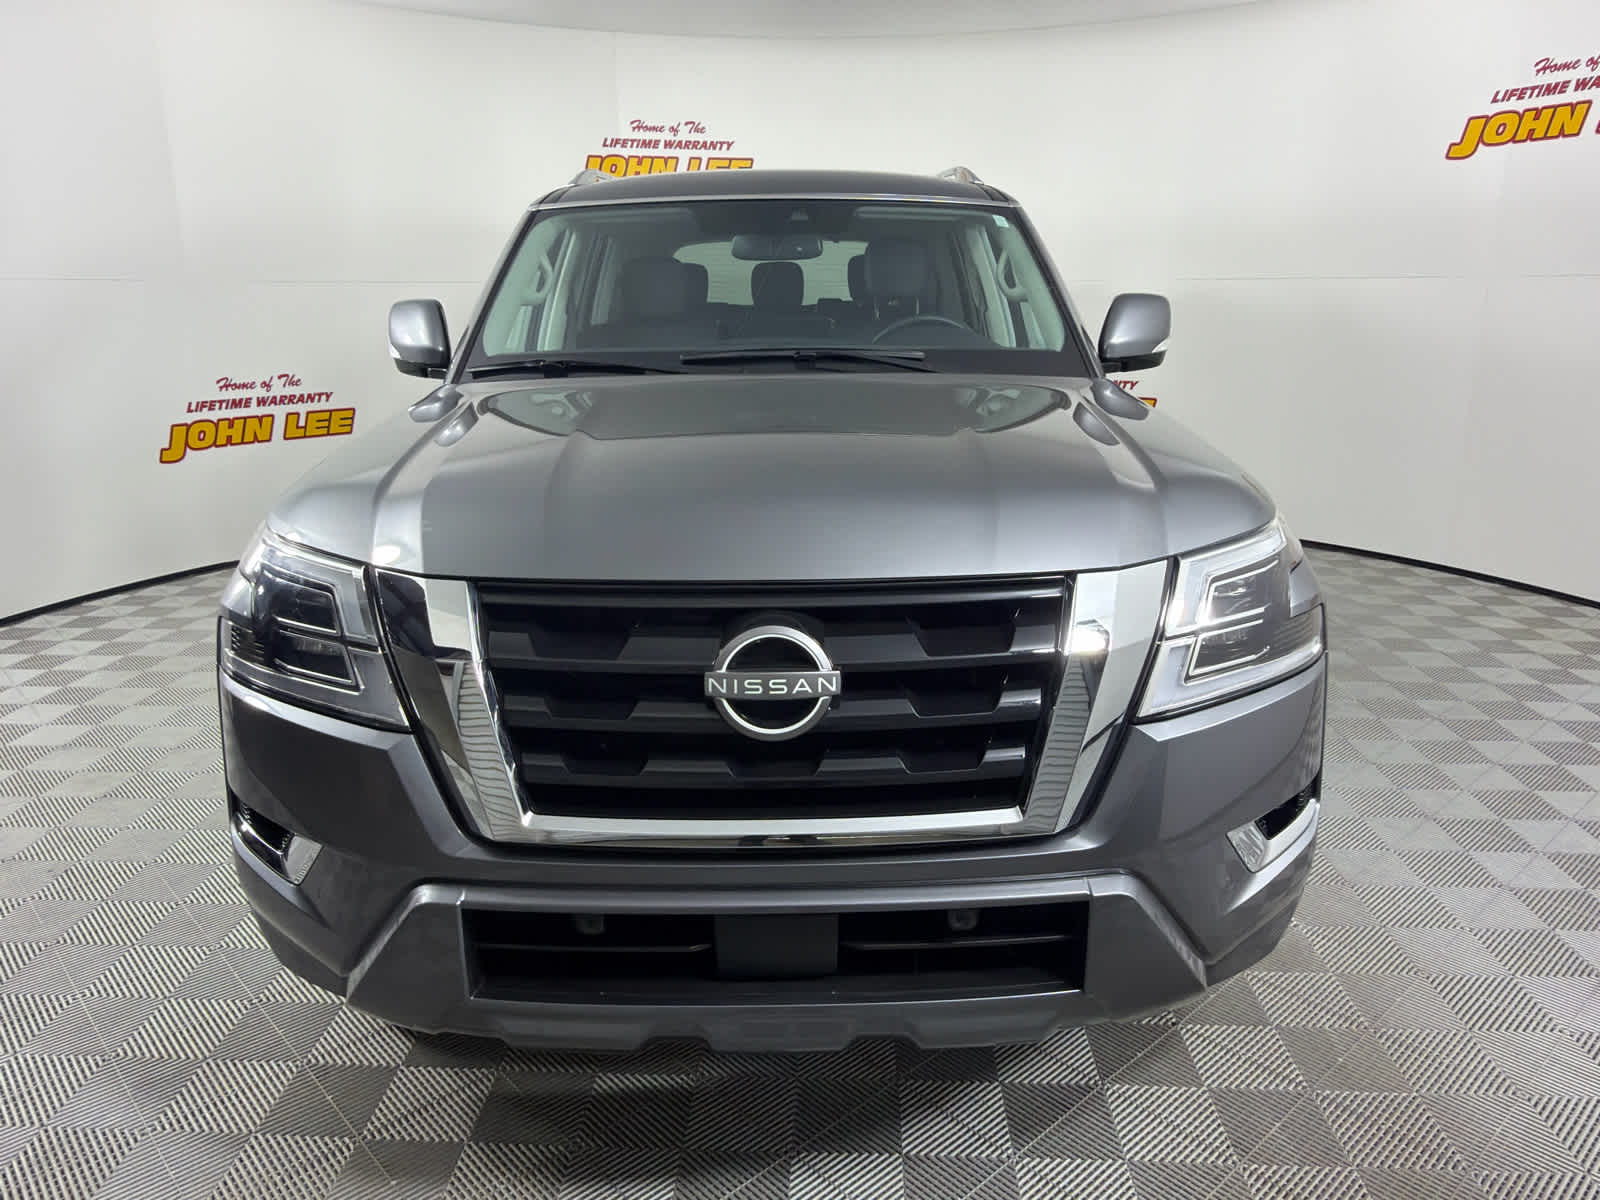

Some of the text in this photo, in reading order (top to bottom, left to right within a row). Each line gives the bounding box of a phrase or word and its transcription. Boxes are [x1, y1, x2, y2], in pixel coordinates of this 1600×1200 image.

[1534, 57, 1581, 76] Home
[1490, 80, 1571, 104] LIFETIME
[630, 119, 706, 136] Home of The
[1445, 99, 1593, 161] JOHN
[602, 137, 735, 151] LIFETIME WARRANTY
[216, 373, 302, 392] Home of The
[186, 391, 334, 413] LIFETIME WARRANTY
[159, 408, 356, 464] JOHN LEE
[707, 676, 838, 695] NISSAN
